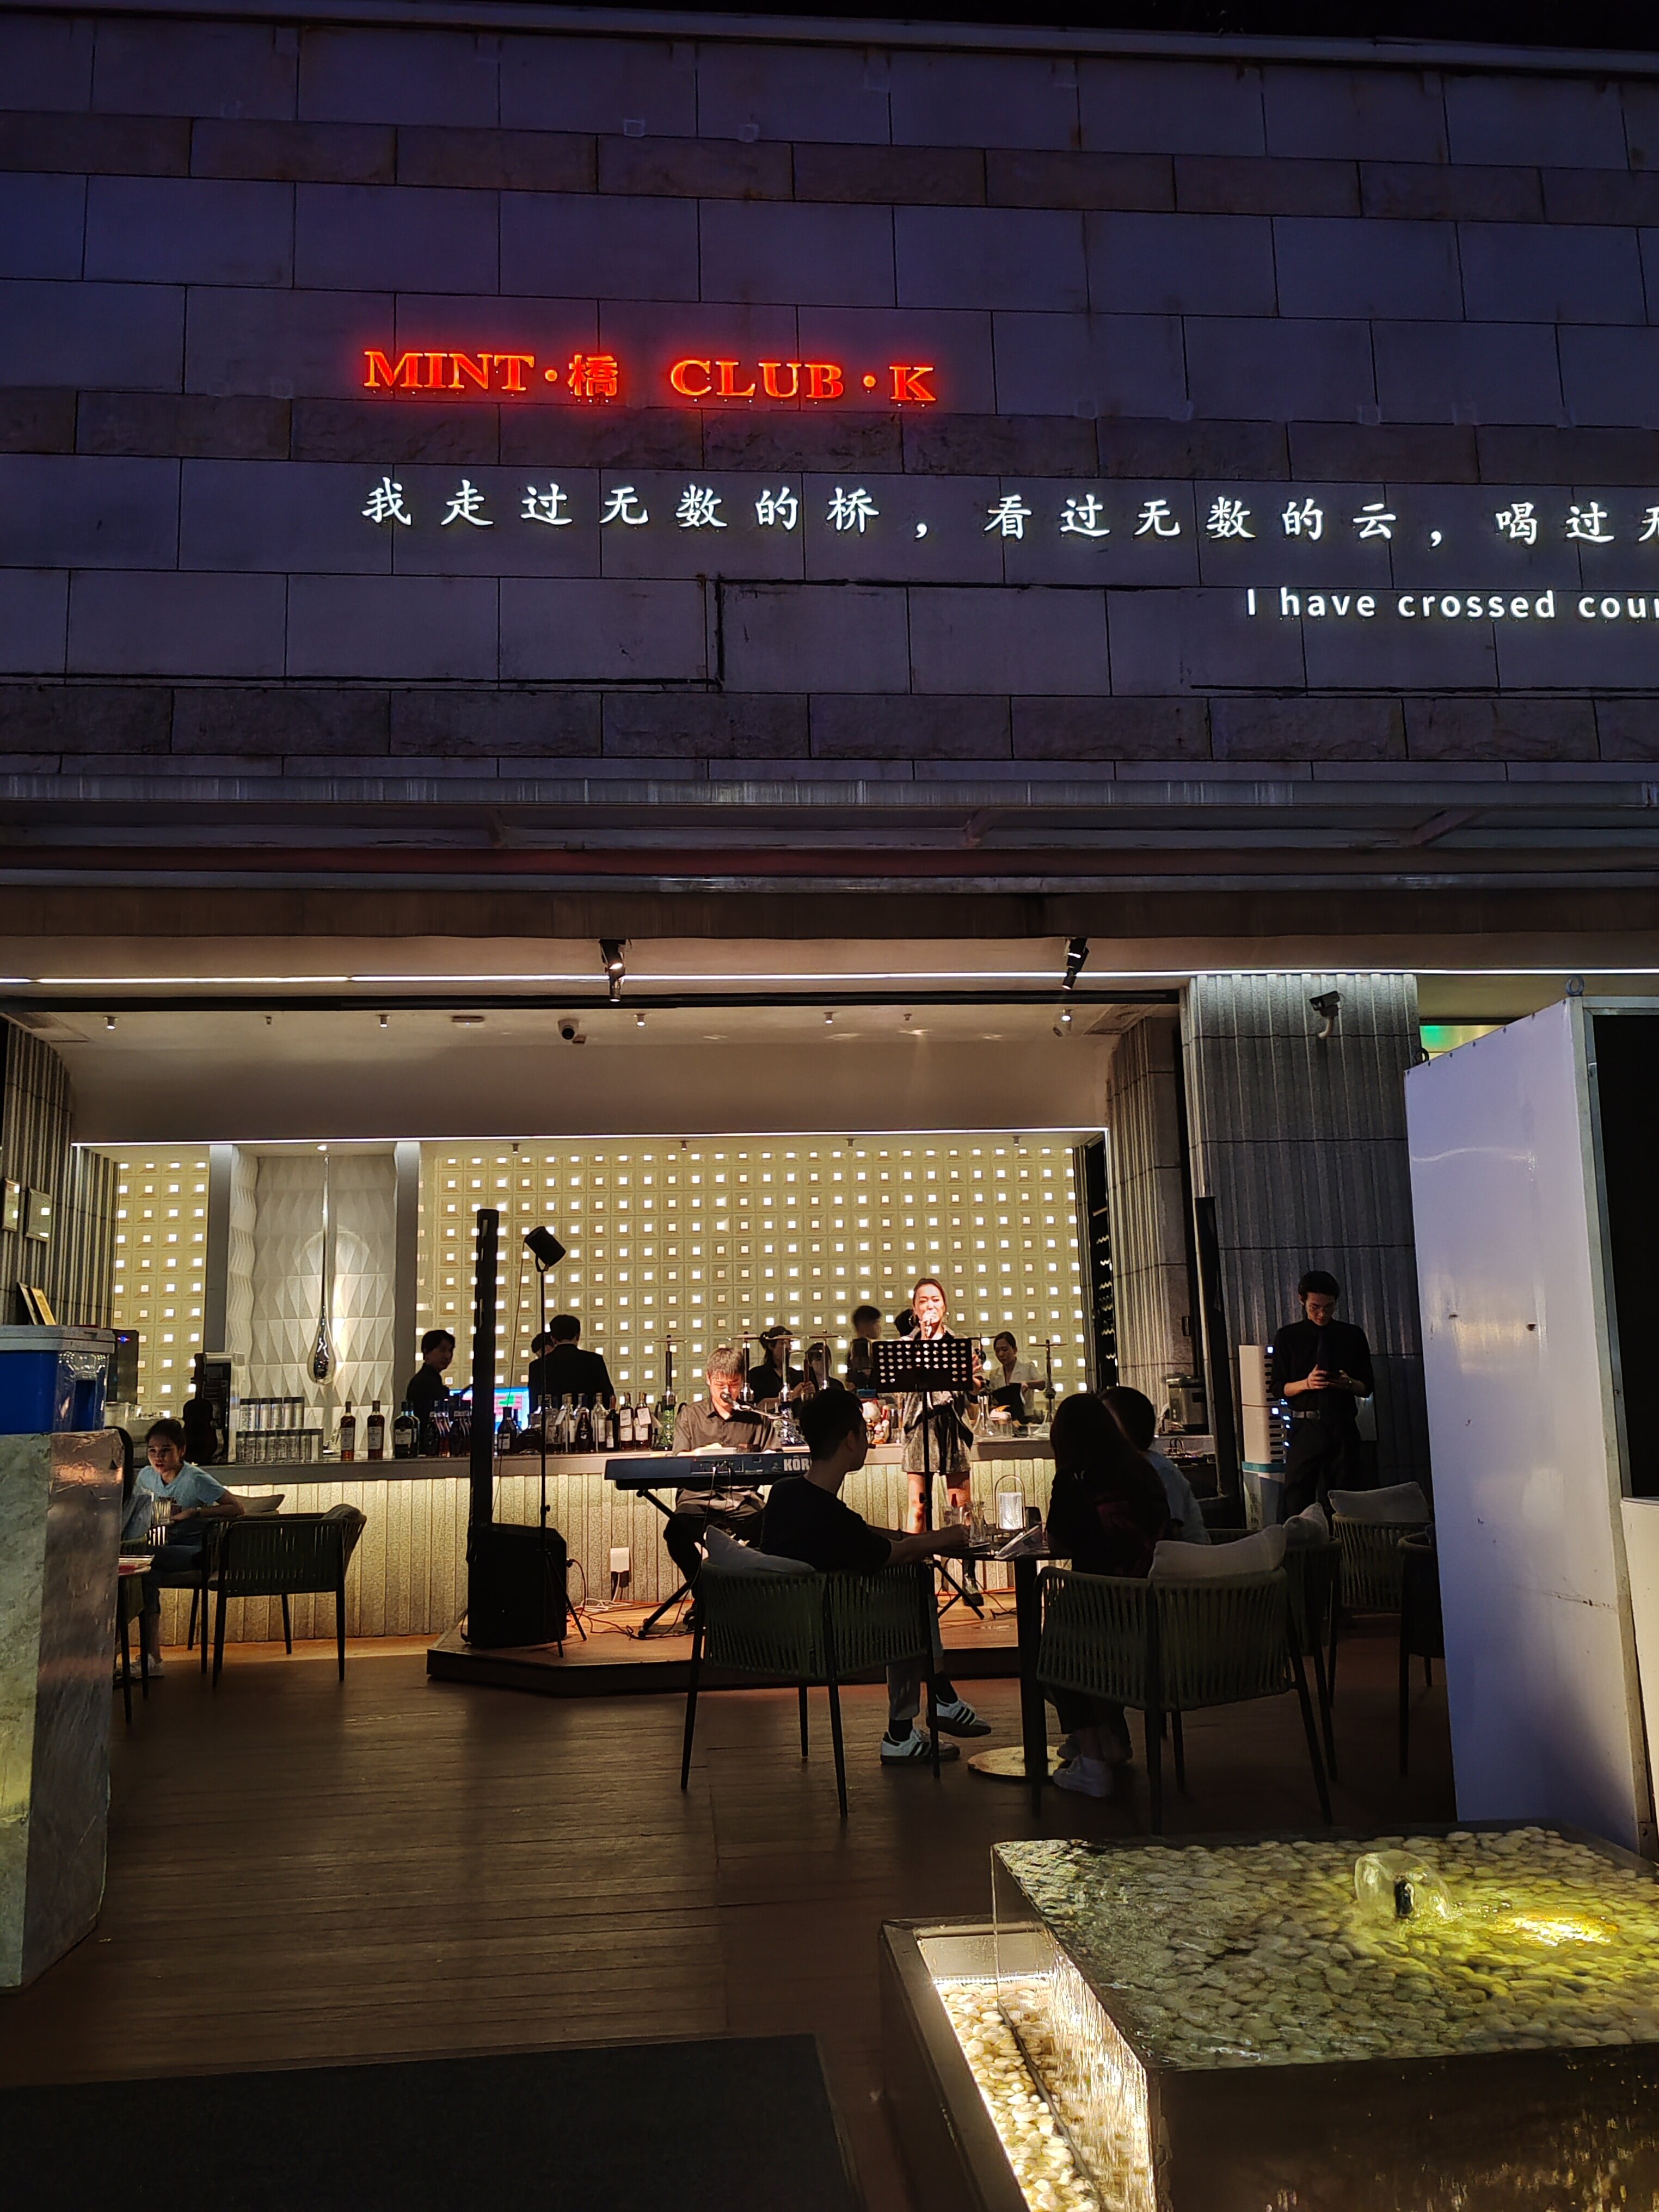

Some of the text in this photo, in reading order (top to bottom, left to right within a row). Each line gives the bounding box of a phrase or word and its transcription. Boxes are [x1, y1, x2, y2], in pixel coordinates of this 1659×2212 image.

[1247, 586, 1659, 619] I have crossed cou
[784, 1458, 813, 1471] KOR
